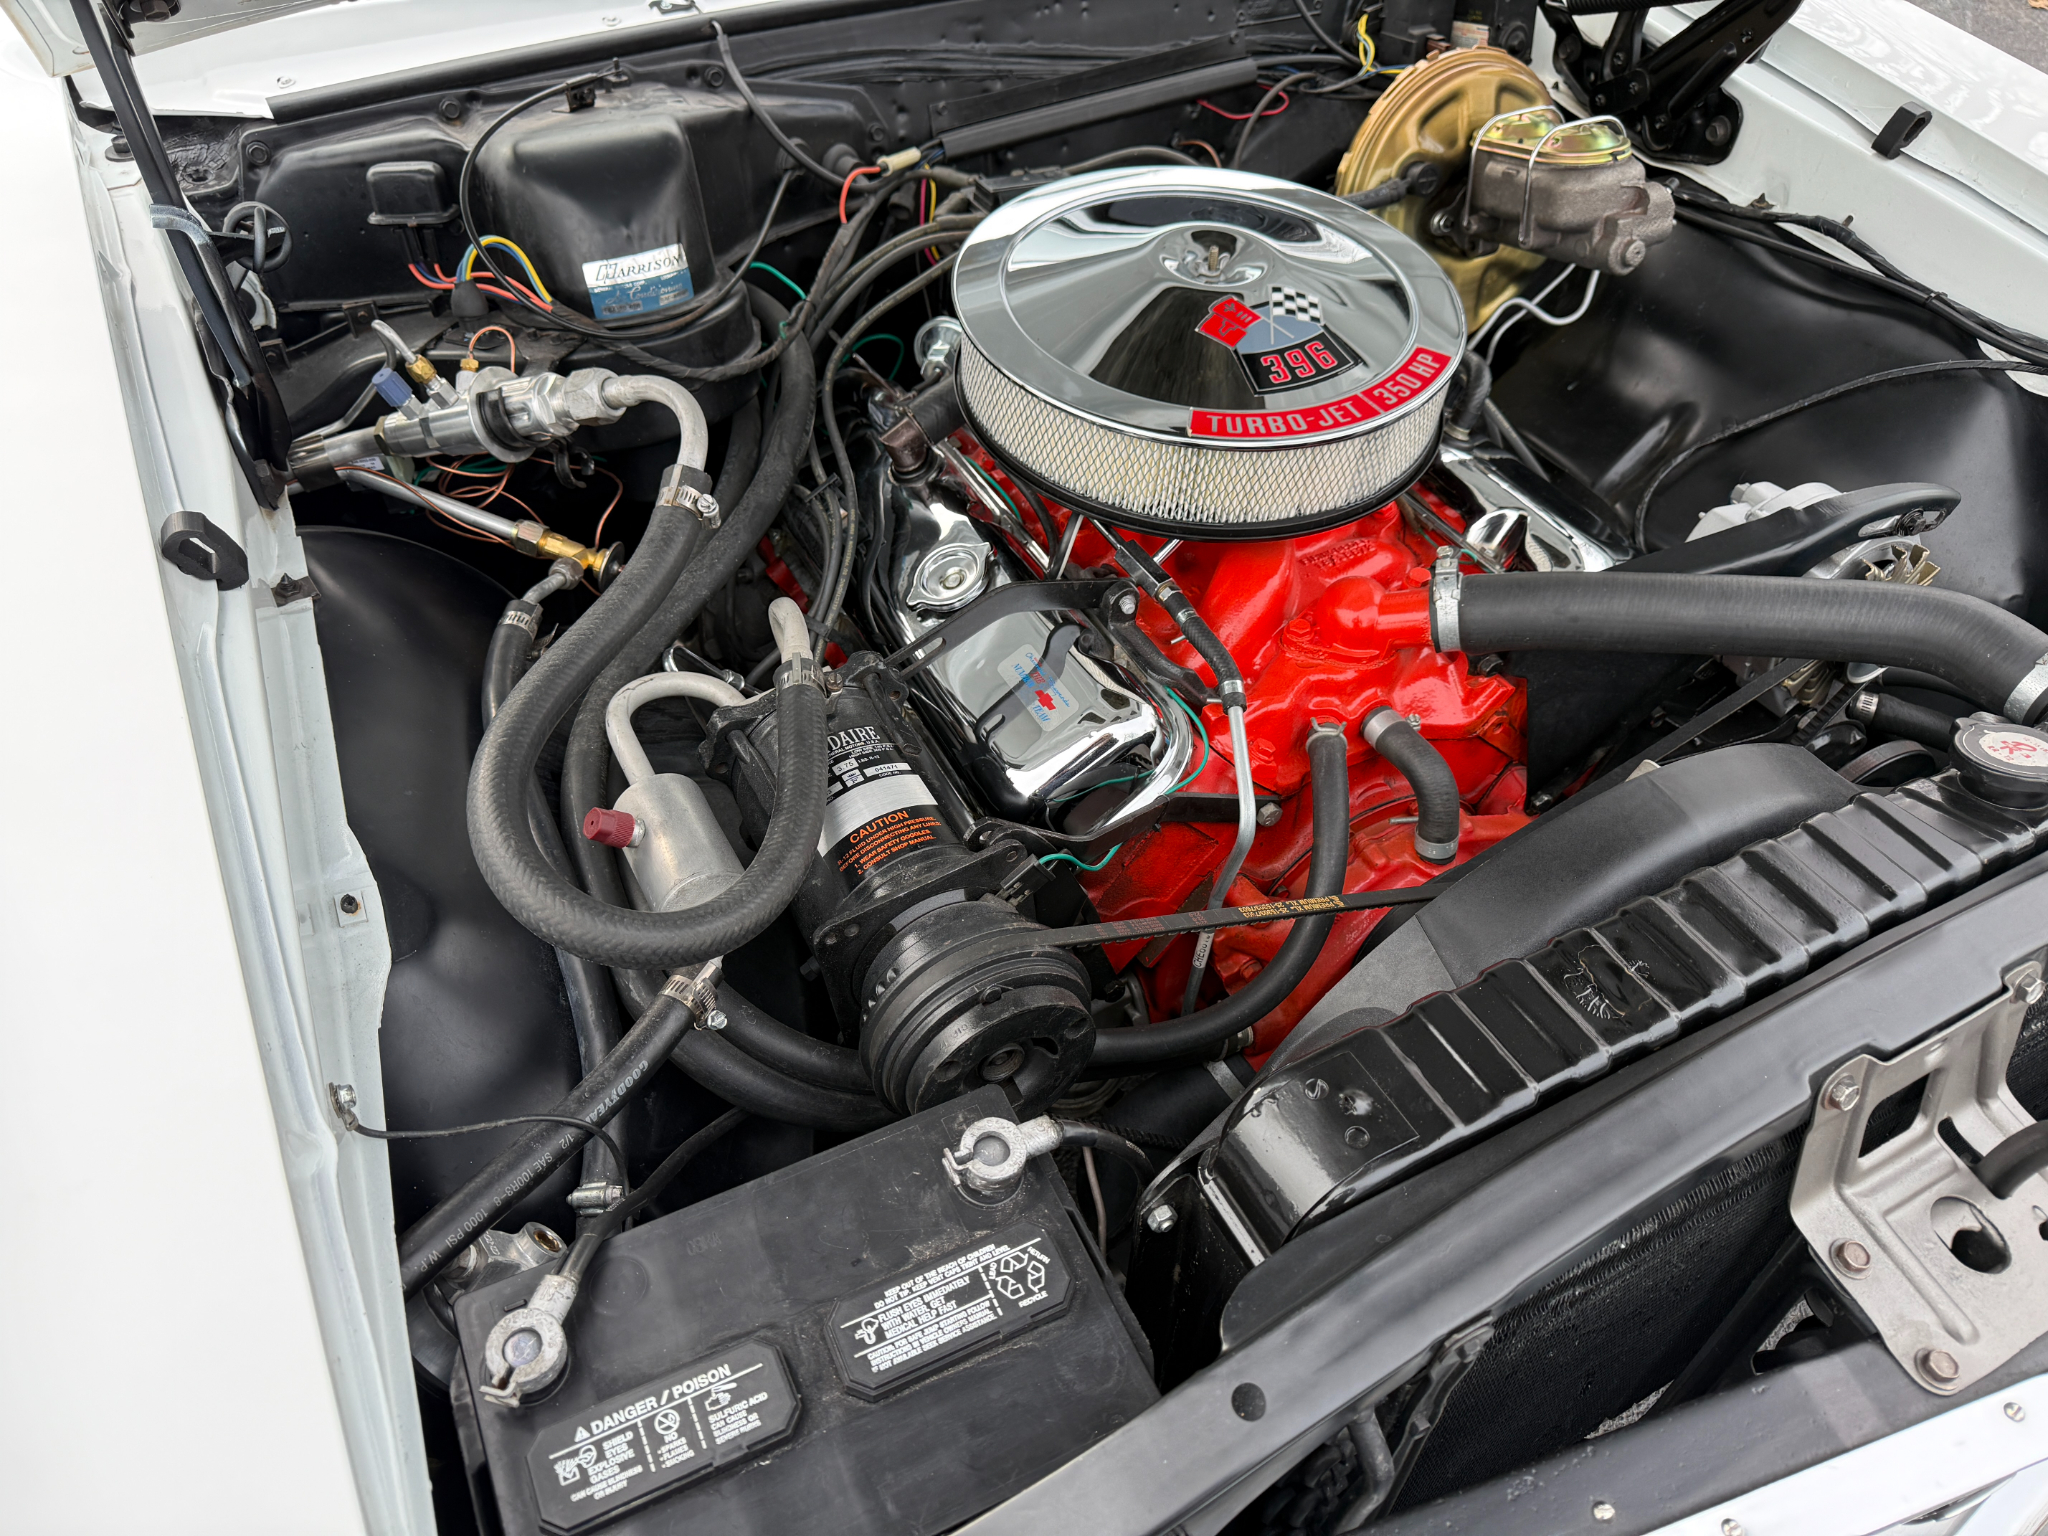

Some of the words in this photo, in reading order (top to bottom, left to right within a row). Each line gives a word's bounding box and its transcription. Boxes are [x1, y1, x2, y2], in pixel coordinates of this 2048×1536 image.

[596, 255, 680, 284] HARRISON
[1260, 341, 1338, 384] 396
[1206, 400, 1362, 434] TURBO-JET
[1373, 372, 1423, 406] 350
[1408, 351, 1442, 378] HP
[1032, 704, 1051, 722] TEAM
[827, 726, 880, 751] DAIRE
[837, 762, 853, 772] 3.75
[849, 810, 909, 843] CAUTION
[849, 841, 866, 856] FLUID
[866, 829, 887, 843] UNDER
[888, 822, 904, 832] HIGH
[839, 854, 861, 872] BEFORE
[860, 827, 910, 855] DISCONNECTING
[910, 823, 922, 831] ANY
[859, 852, 877, 864] WEAR
[877, 838, 900, 853] SAFETY
[863, 850, 891, 870] CONSULT
[891, 842, 909, 853] SHOP
[1299, 896, 1330, 905] PREMIUM
[1304, 901, 1335, 911] PREMIUM
[558, 1133, 575, 1150] 1/2
[533, 1152, 553, 1172] SAE
[493, 1167, 535, 1207] 100R3-8
[463, 1208, 488, 1233] 1000
[445, 1230, 464, 1249] PSI
[1027, 1246, 1051, 1264] RETURN
[874, 1300, 885, 1309] DO
[884, 1295, 899, 1305] NOT
[911, 1281, 928, 1292] KEEP
[929, 1274, 944, 1285] VENT
[944, 1268, 961, 1278] CAPS
[961, 1258, 979, 1271] TIGHT
[979, 1253, 992, 1263] AND
[884, 1286, 901, 1298] KEEP
[901, 1280, 914, 1290] OUT
[914, 1275, 924, 1284] OF
[923, 1268, 938, 1279] THE
[937, 1259, 957, 1273] REACH
[957, 1255, 967, 1264] OF
[966, 1243, 996, 1261] CHILDREN
[989, 1261, 997, 1280] LEAD
[878, 1306, 903, 1323] FLUSH
[903, 1296, 923, 1311] EYES
[923, 1275, 971, 1303] IMMEDIATELY
[1018, 1290, 1049, 1308] RECYCLE
[880, 1314, 902, 1331] WITH
[930, 1296, 947, 1309] GET
[884, 1319, 918, 1340] MEDICAL
[918, 1309, 938, 1325] HELP
[938, 1300, 958, 1316] FAST
[897, 1338, 908, 1348] FOR
[908, 1331, 923, 1343] SAFE
[923, 1324, 939, 1337] JUMP
[939, 1311, 967, 1329] STARTING
[966, 1300, 991, 1318] FOLLOW
[870, 1345, 913, 1367] INSTRUCTIONS
[912, 1341, 920, 1350] IN
[919, 1328, 944, 1345] VEHICLE
[871, 1366, 880, 1374] IF
[880, 1360, 893, 1371] NOT
[893, 1346, 923, 1365] AVAILABLE
[922, 1340, 939, 1352] SEEK
[939, 1328, 962, 1345] SERVICE
[590, 1396, 658, 1435] DANGER
[660, 1389, 669, 1405] /
[672, 1364, 731, 1399] POISON
[708, 1400, 748, 1423] SULFURIC
[749, 1391, 768, 1406] ACID
[710, 1421, 726, 1431] CAN
[726, 1410, 747, 1424] CAUSE
[712, 1418, 747, 1437] BLINDNESS
[747, 1412, 759, 1422] OR
[602, 1431, 634, 1451] SHIELD
[660, 1437, 687, 1453] SPARKS
[664, 1431, 678, 1443] NO
[715, 1429, 740, 1445] SEVERE
[587, 1448, 635, 1476] EXPLOSIVE
[605, 1442, 628, 1459] EYES
[663, 1444, 689, 1460] FLAMES
[665, 1449, 695, 1468] SMOKING
[570, 1490, 587, 1502] CAN
[586, 1482, 607, 1495] CAUSE
[606, 1465, 643, 1488] BLINDNESS
[589, 1465, 620, 1484] GASES
[593, 1491, 605, 1500] OR
